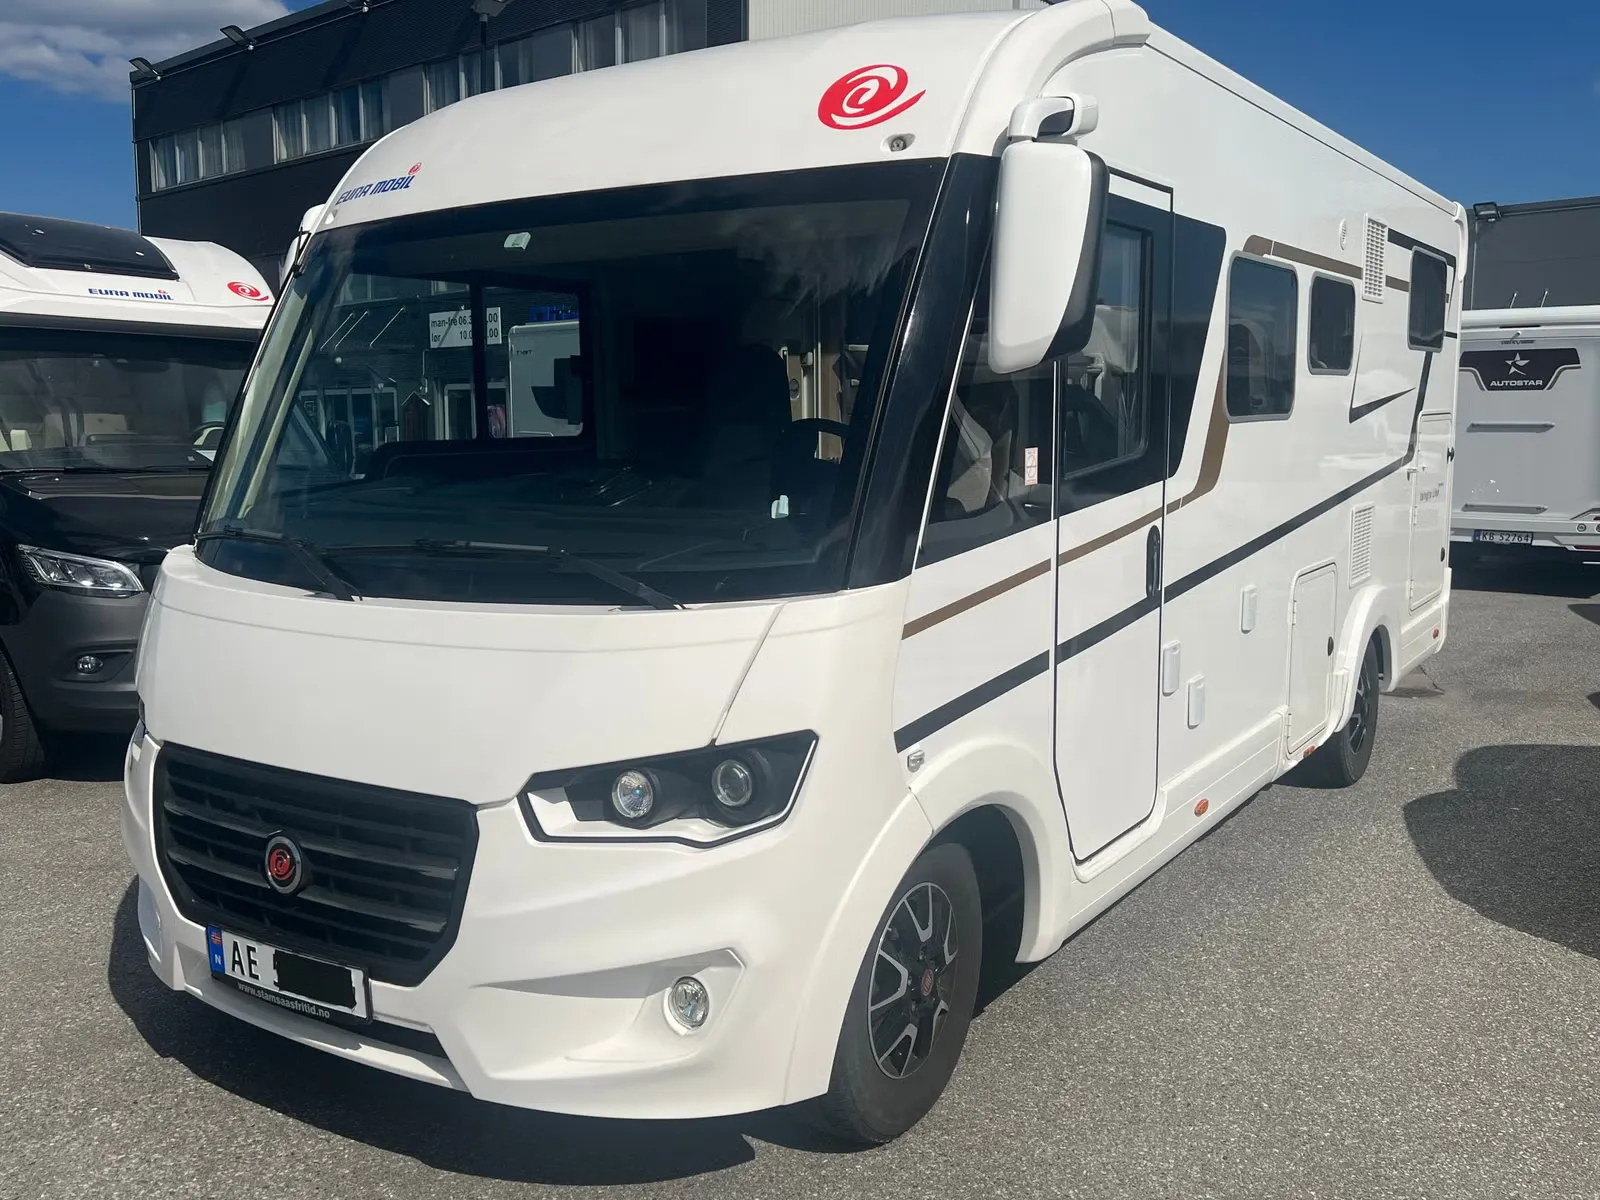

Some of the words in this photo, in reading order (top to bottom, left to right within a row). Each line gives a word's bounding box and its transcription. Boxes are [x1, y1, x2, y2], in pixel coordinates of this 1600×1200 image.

[335, 183, 374, 206] EURA
[369, 175, 416, 196] MOBIL
[88, 288, 130, 297] EURA
[132, 291, 174, 300] MOBIL
[1489, 379, 1544, 388] AUTOSTAR
[1482, 531, 1495, 541] KB
[1499, 532, 1530, 543] 52764
[214, 953, 222, 965] N
